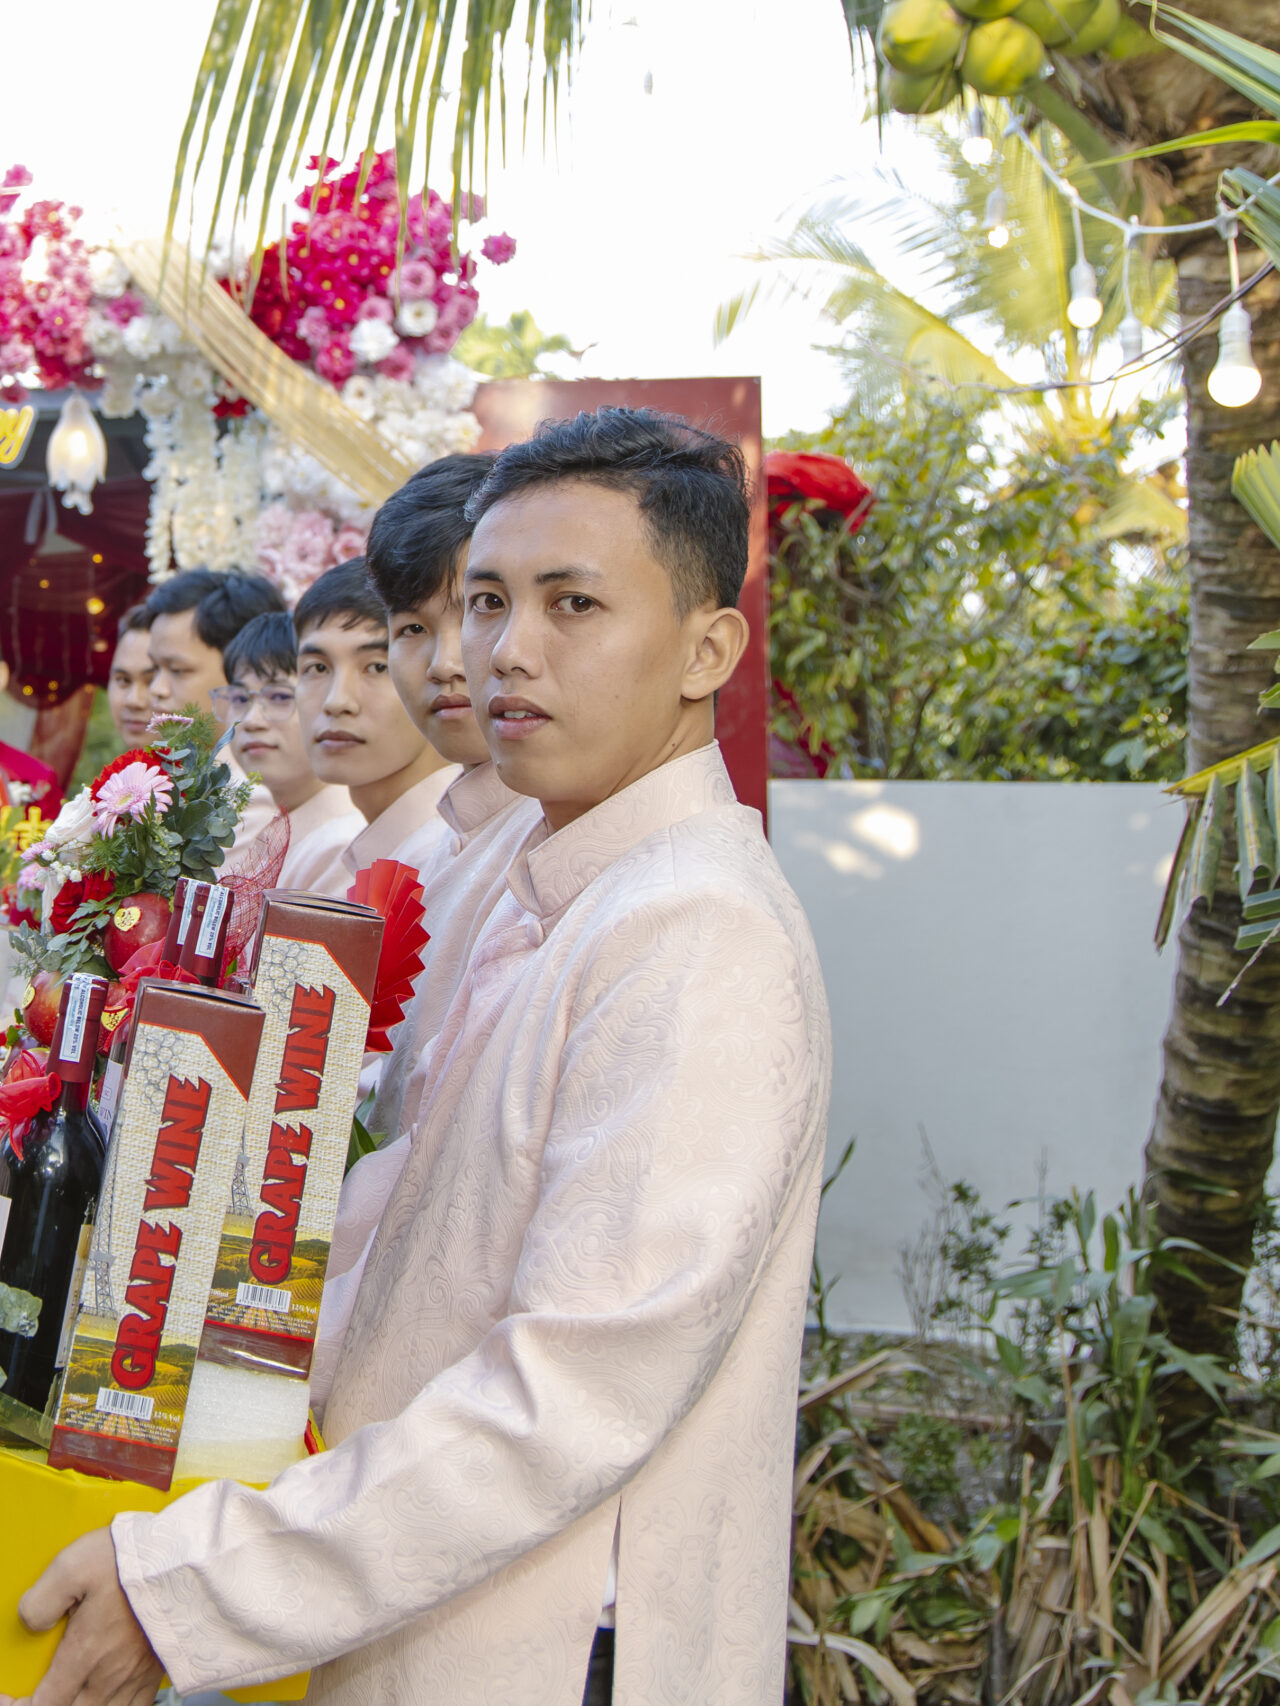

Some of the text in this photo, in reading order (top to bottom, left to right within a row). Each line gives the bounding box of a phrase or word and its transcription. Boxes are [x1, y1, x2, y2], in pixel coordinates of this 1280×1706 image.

[274, 982, 336, 1116] WINE
[143, 1073, 212, 1213] WINE
[249, 1120, 313, 1285] GRAPE
[111, 1218, 183, 1390] GRAPE
